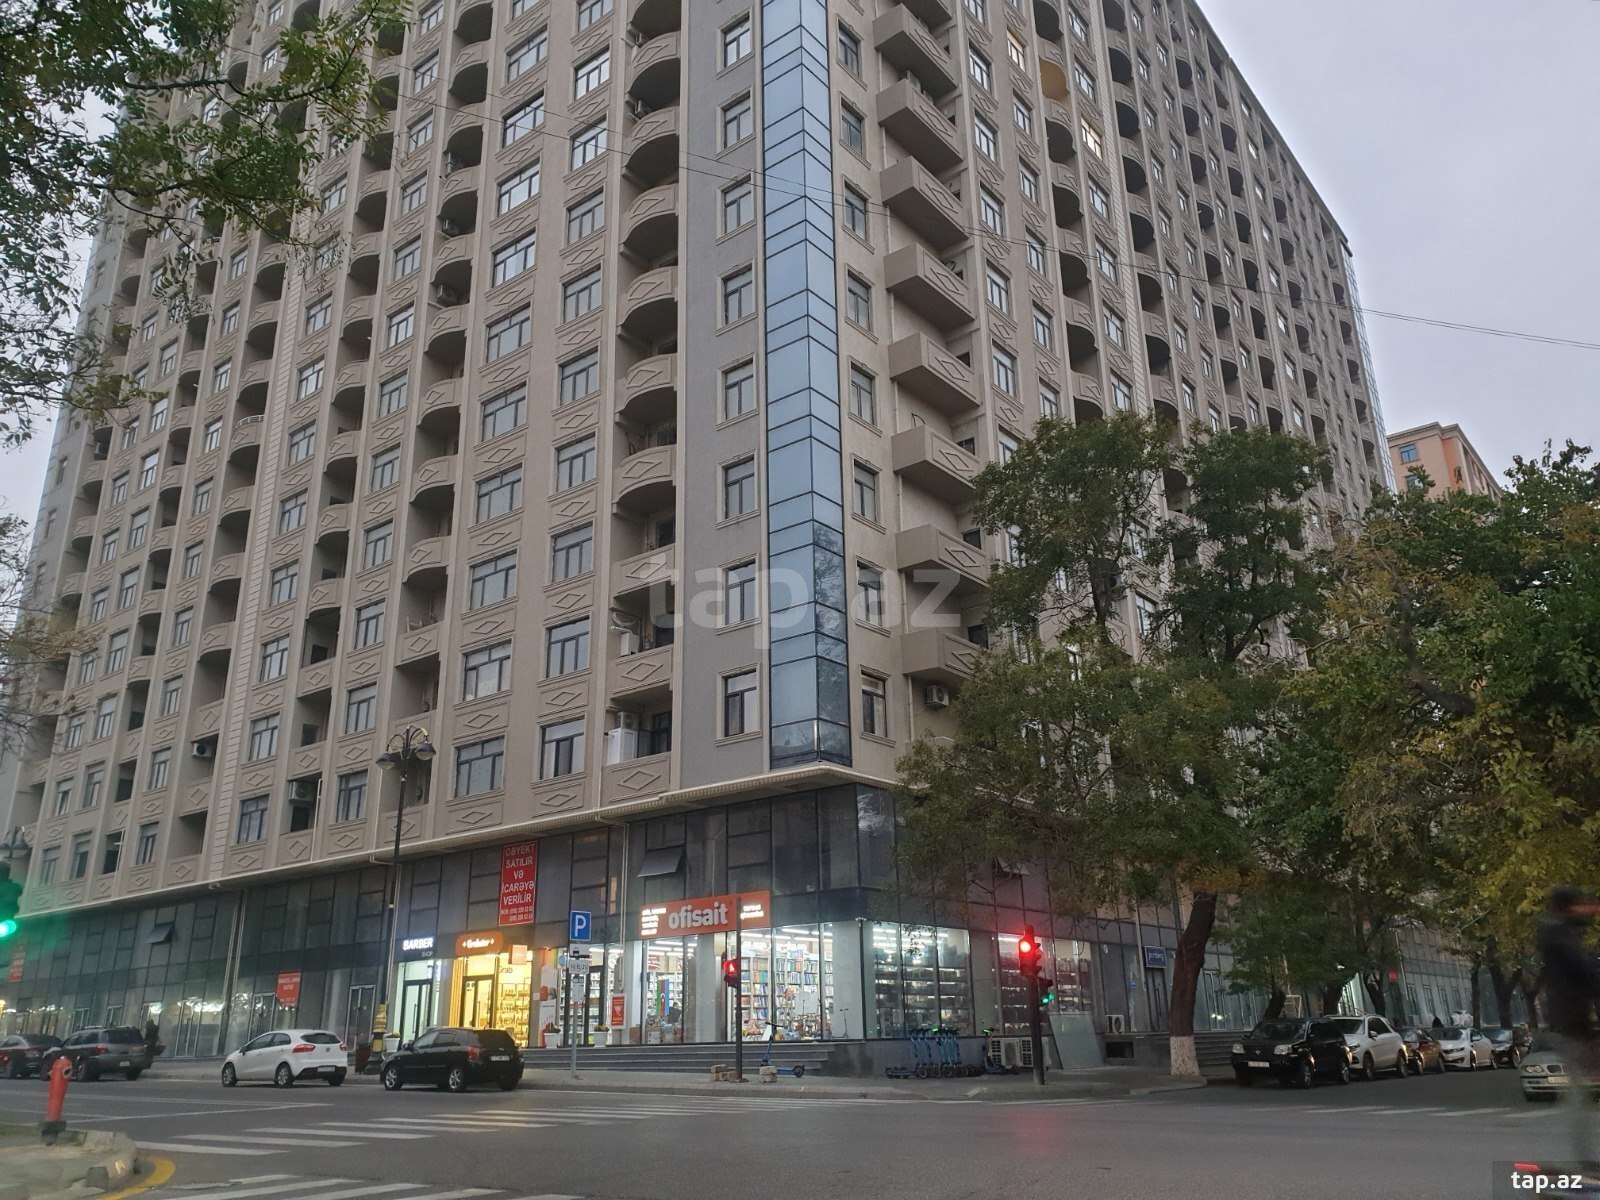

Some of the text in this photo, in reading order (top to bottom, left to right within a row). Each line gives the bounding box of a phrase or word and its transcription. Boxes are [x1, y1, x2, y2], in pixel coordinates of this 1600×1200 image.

[505, 843, 536, 857] OBYEKT
[506, 856, 533, 869] SATILIR
[668, 901, 728, 930] ofisait
[574, 914, 587, 938] P
[402, 937, 434, 951] BARBER
[421, 950, 434, 958] SHOP
